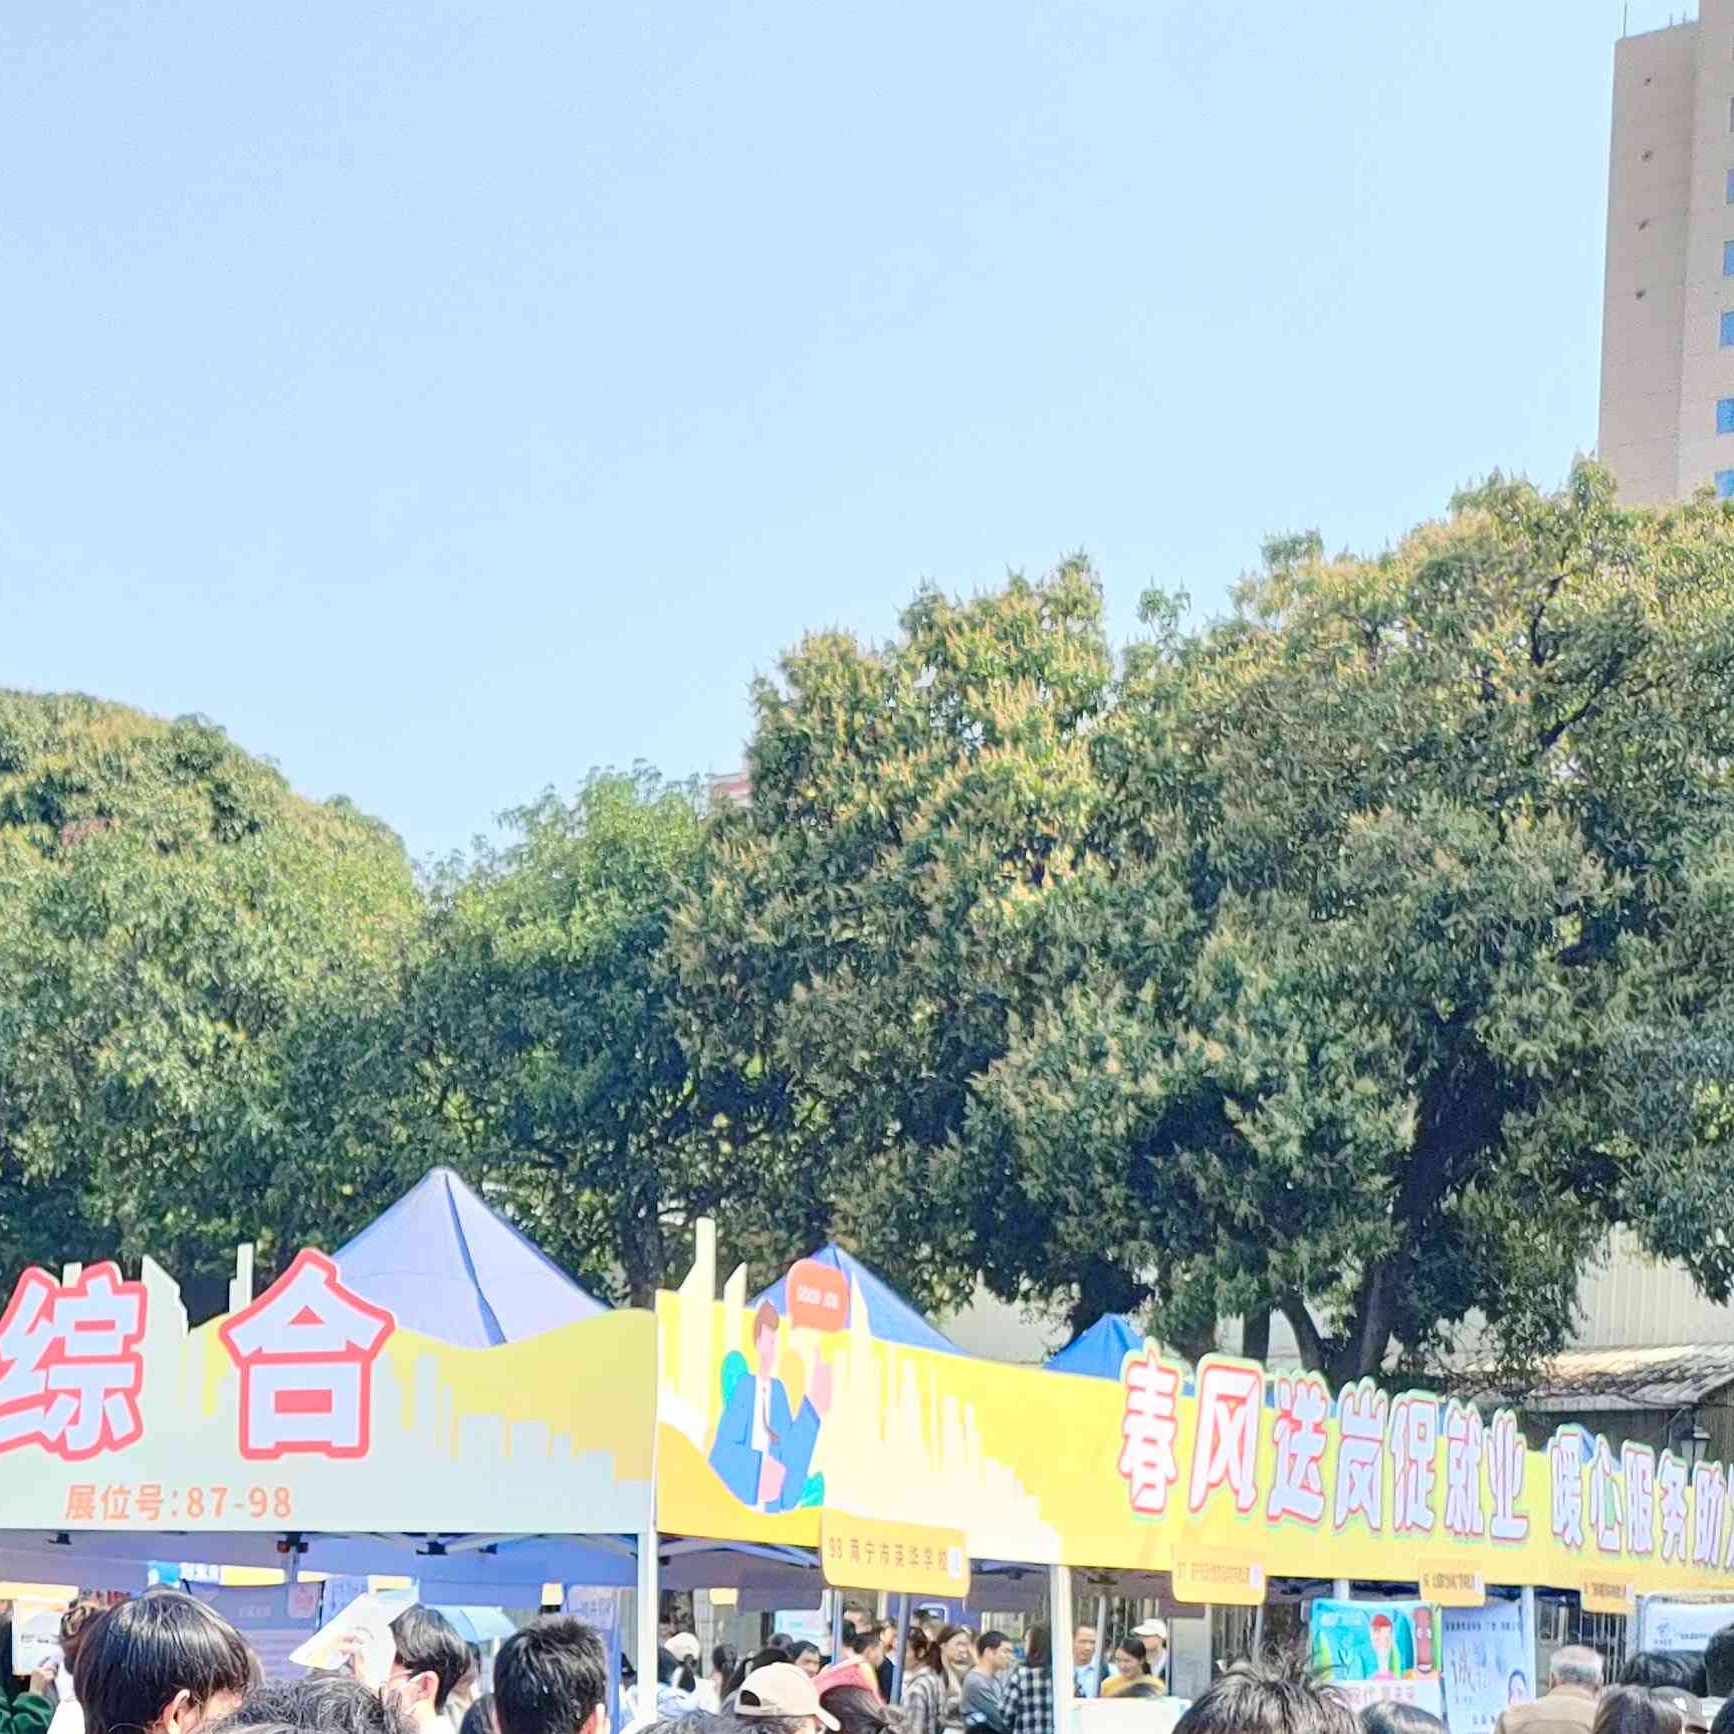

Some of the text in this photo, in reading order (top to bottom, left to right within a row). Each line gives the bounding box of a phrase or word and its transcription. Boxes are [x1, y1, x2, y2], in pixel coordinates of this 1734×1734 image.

[65, 1484, 292, 1521] 展位号:87-98
[1118, 1348, 1734, 1572] 春风送岗促就业 暖心服务助
